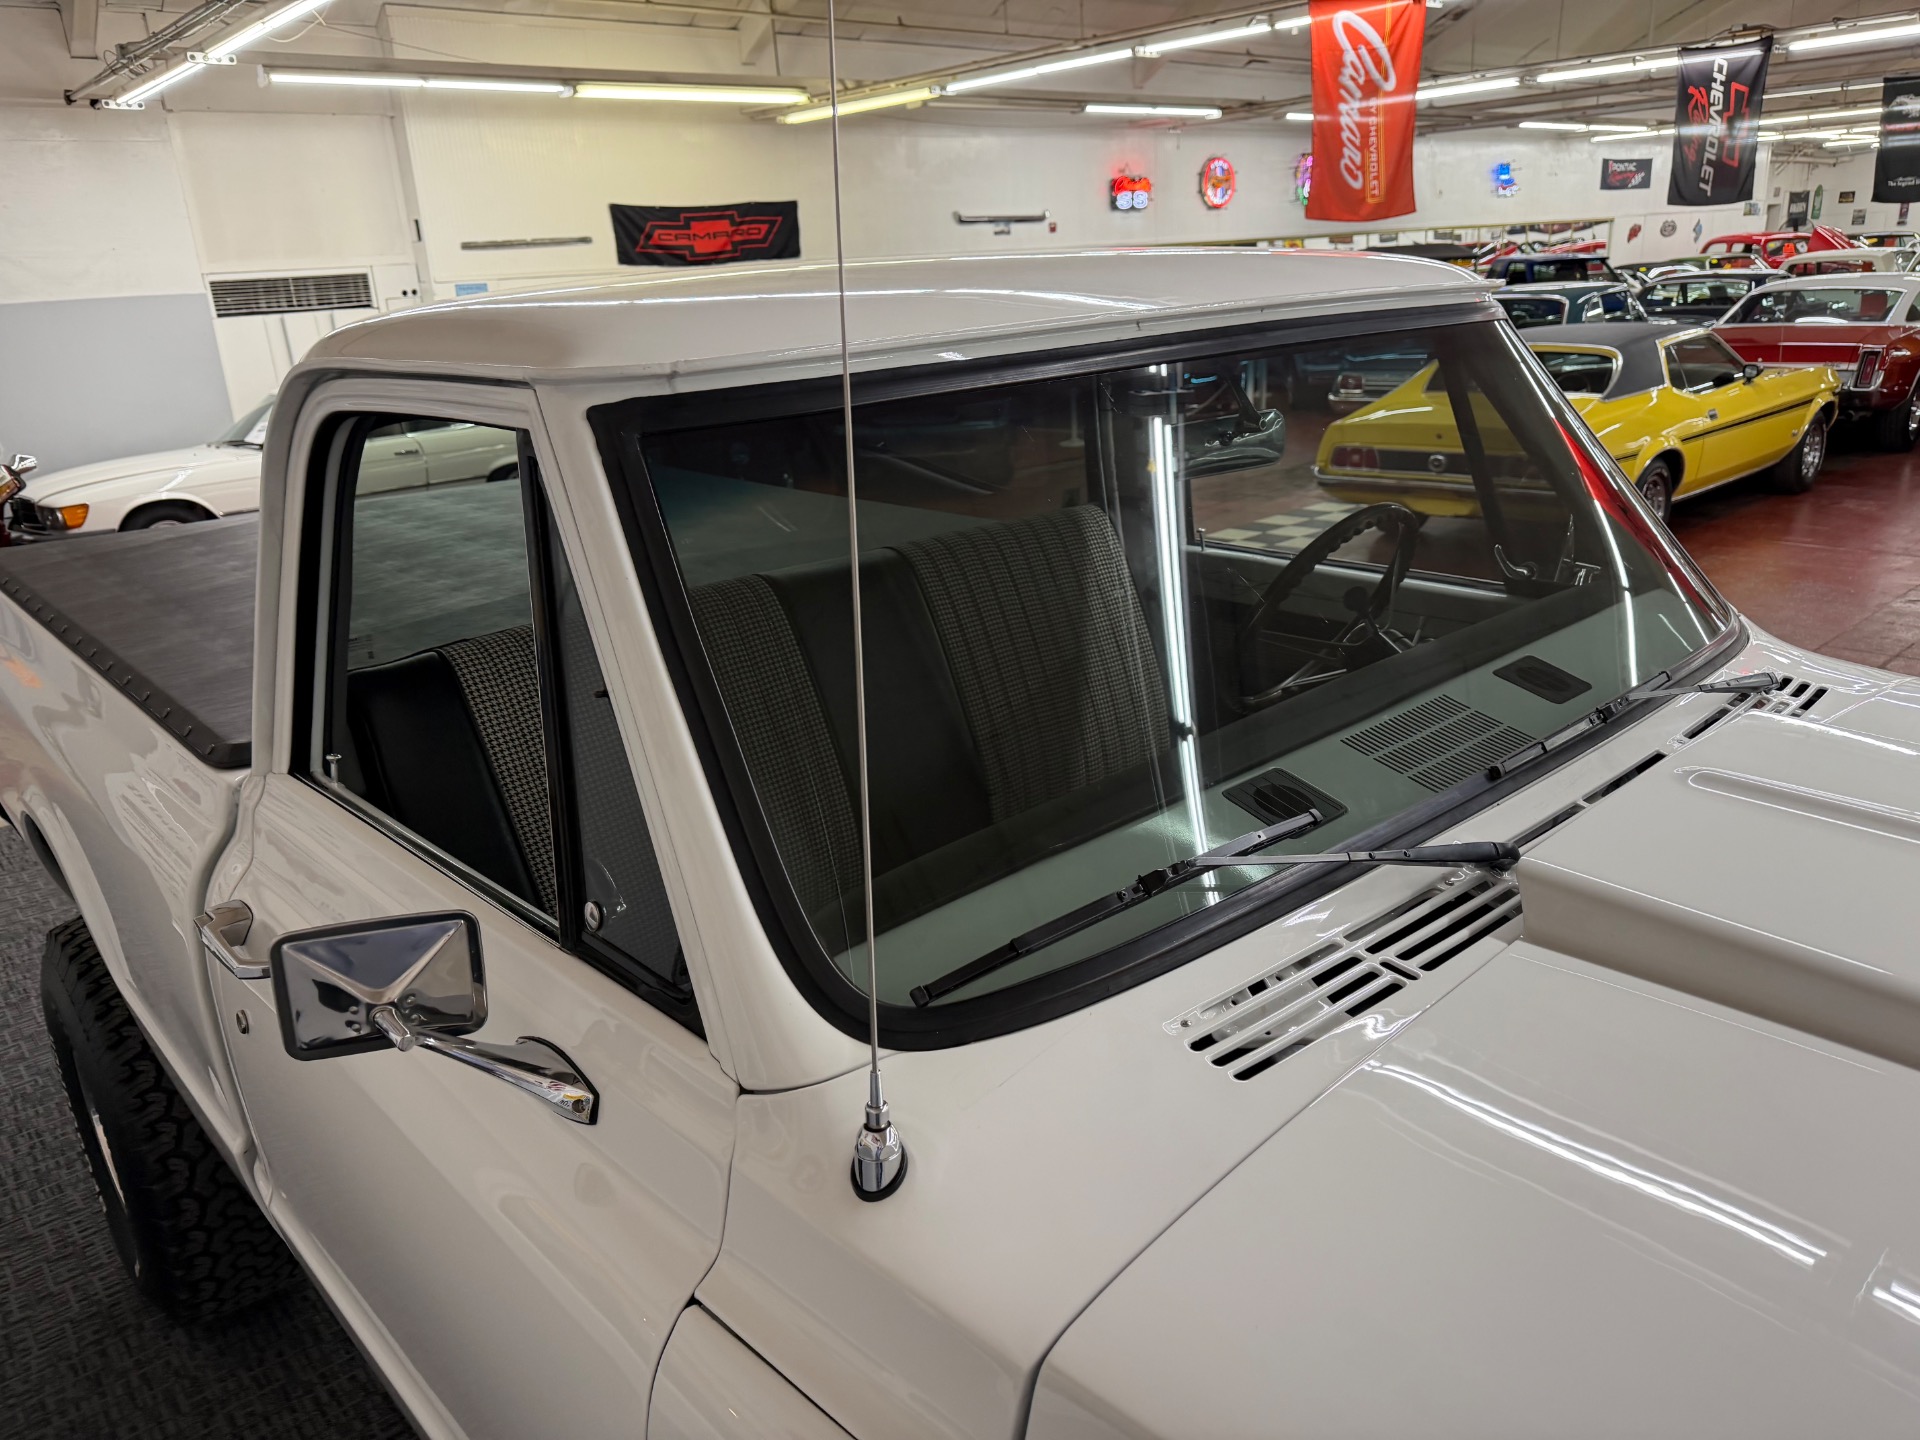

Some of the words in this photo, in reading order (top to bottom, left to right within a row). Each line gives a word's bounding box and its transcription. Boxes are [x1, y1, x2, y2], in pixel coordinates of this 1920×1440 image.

[1332, 10, 1397, 190] Camaro
[1683, 85, 1709, 170] Raing
[1699, 57, 1728, 197] CHEVROLET
[1368, 116, 1379, 197] CHEVROLET
[657, 227, 762, 242] CAMARO
[1116, 190, 1148, 209] SS
